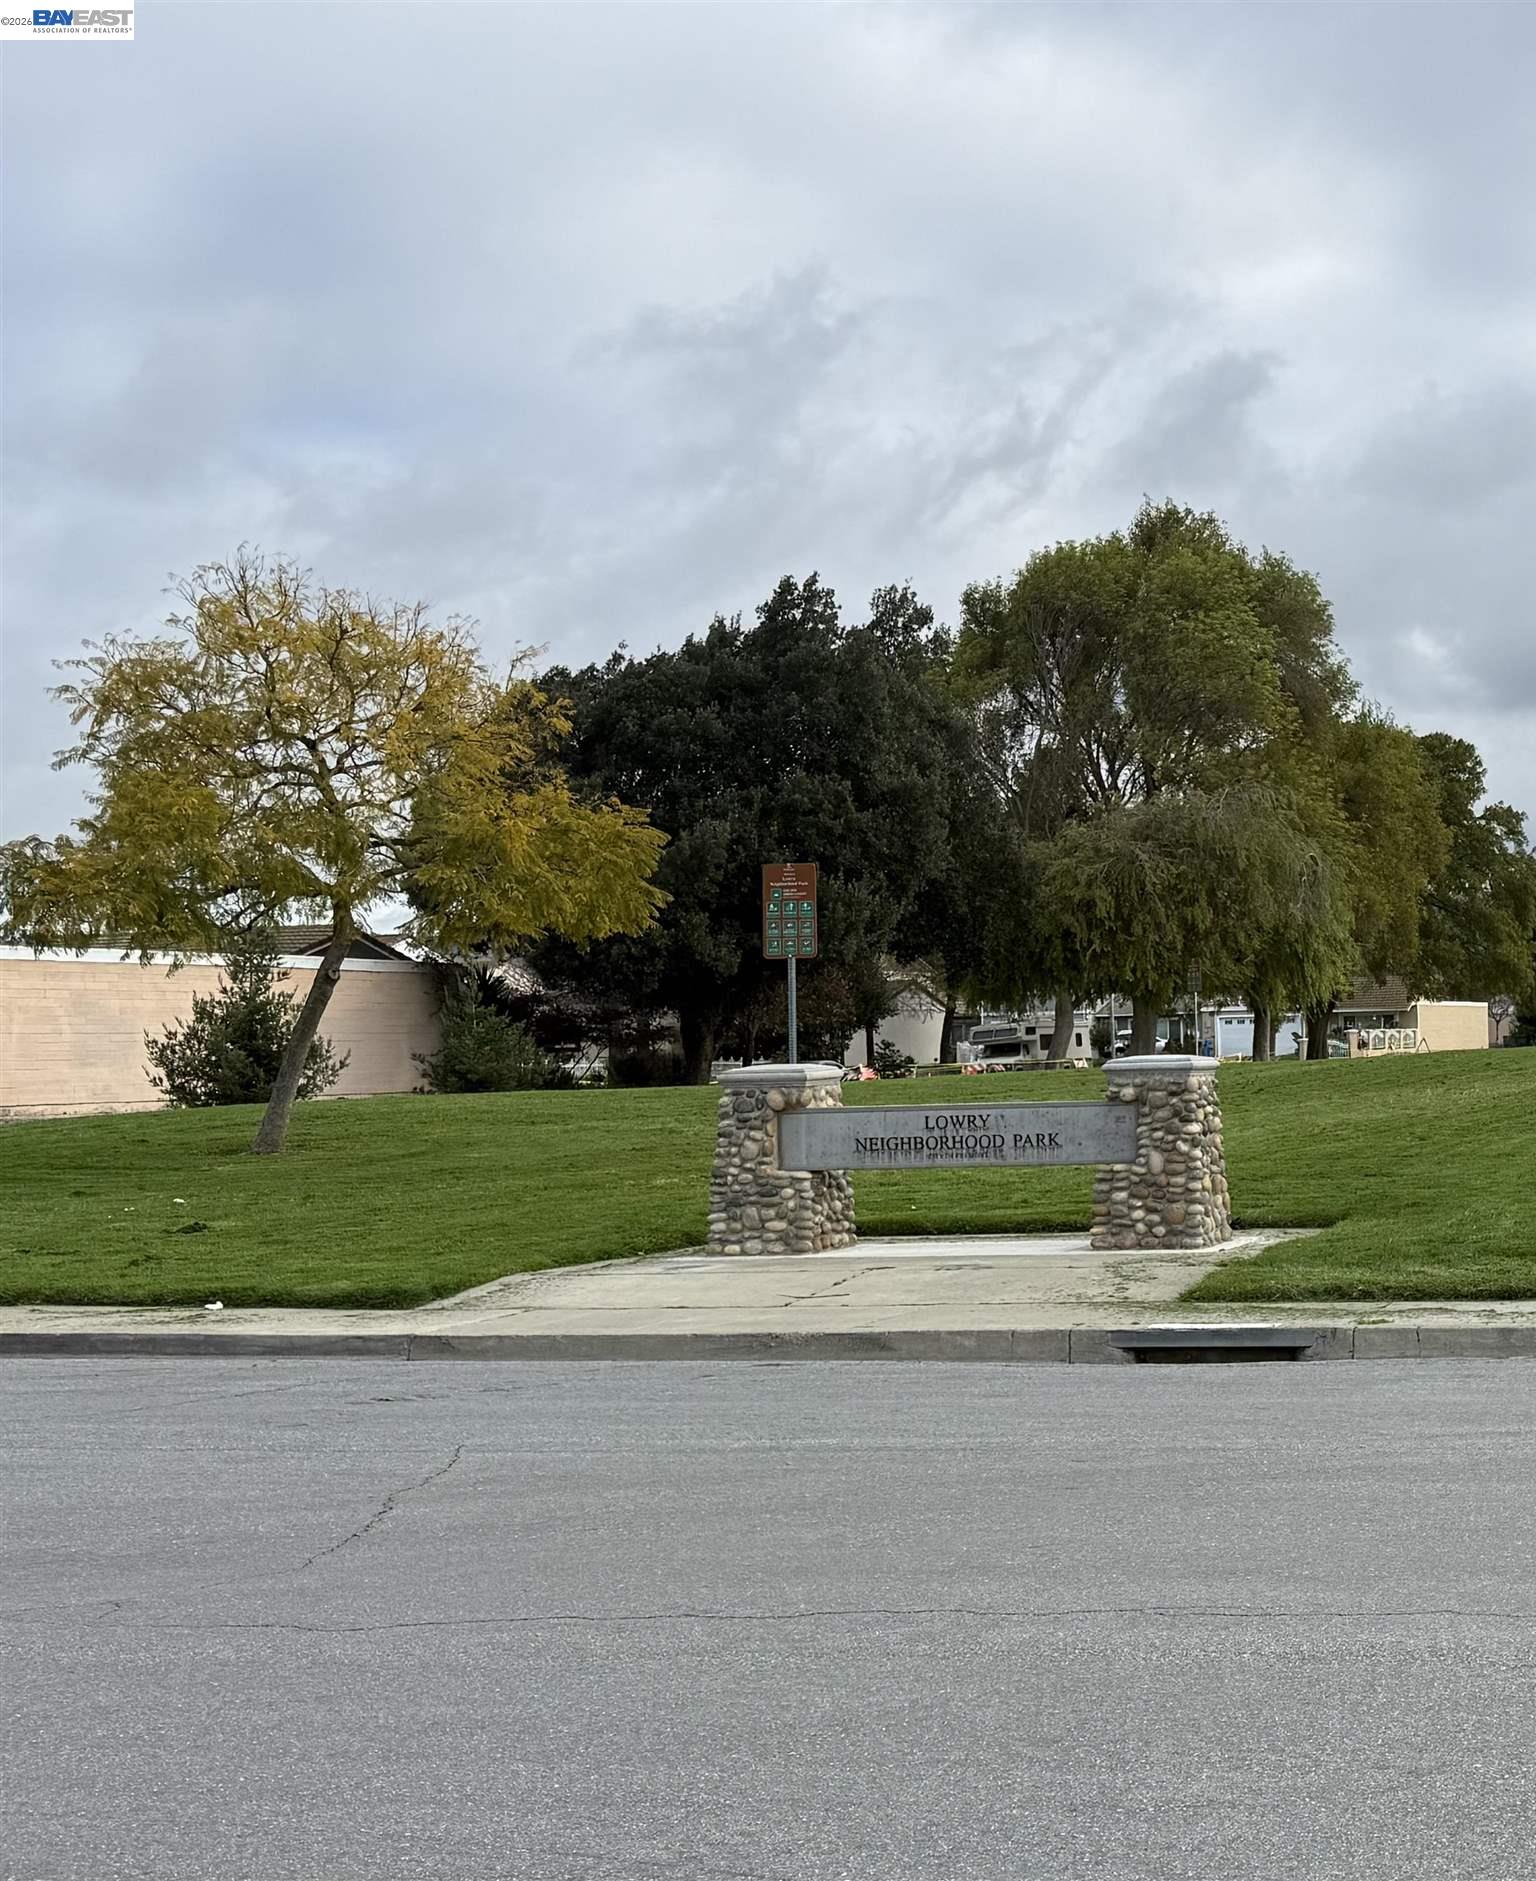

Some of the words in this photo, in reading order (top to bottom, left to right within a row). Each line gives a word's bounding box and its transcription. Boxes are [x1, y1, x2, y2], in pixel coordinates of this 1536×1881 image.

[924, 1114, 990, 1129] LOWRY
[855, 1135, 1005, 1150] NEIGHBORHOOD
[1013, 1132, 1060, 1148] PARK
